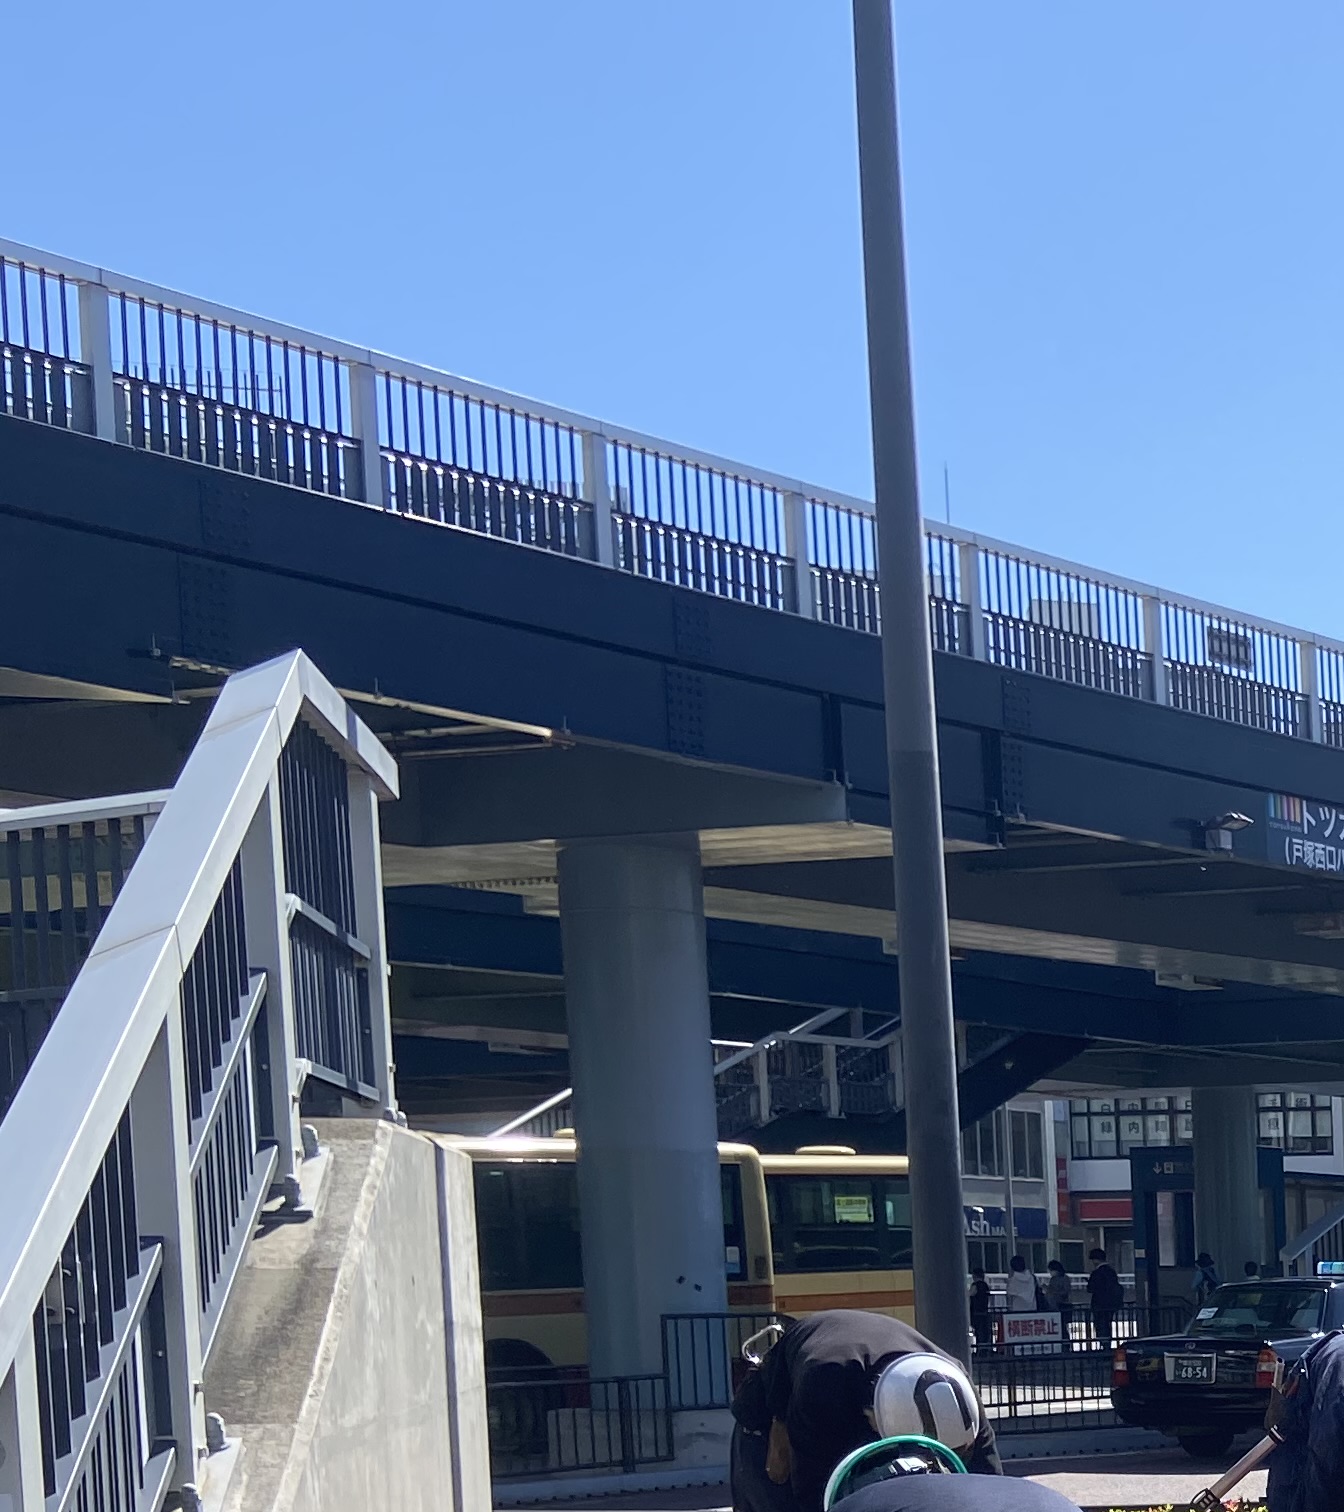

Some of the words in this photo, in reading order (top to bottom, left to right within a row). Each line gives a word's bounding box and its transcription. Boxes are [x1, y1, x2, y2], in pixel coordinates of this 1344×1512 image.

[1008, 1318, 1059, 1338] 横断禁止
[1181, 1366, 1208, 1378] 68-54
